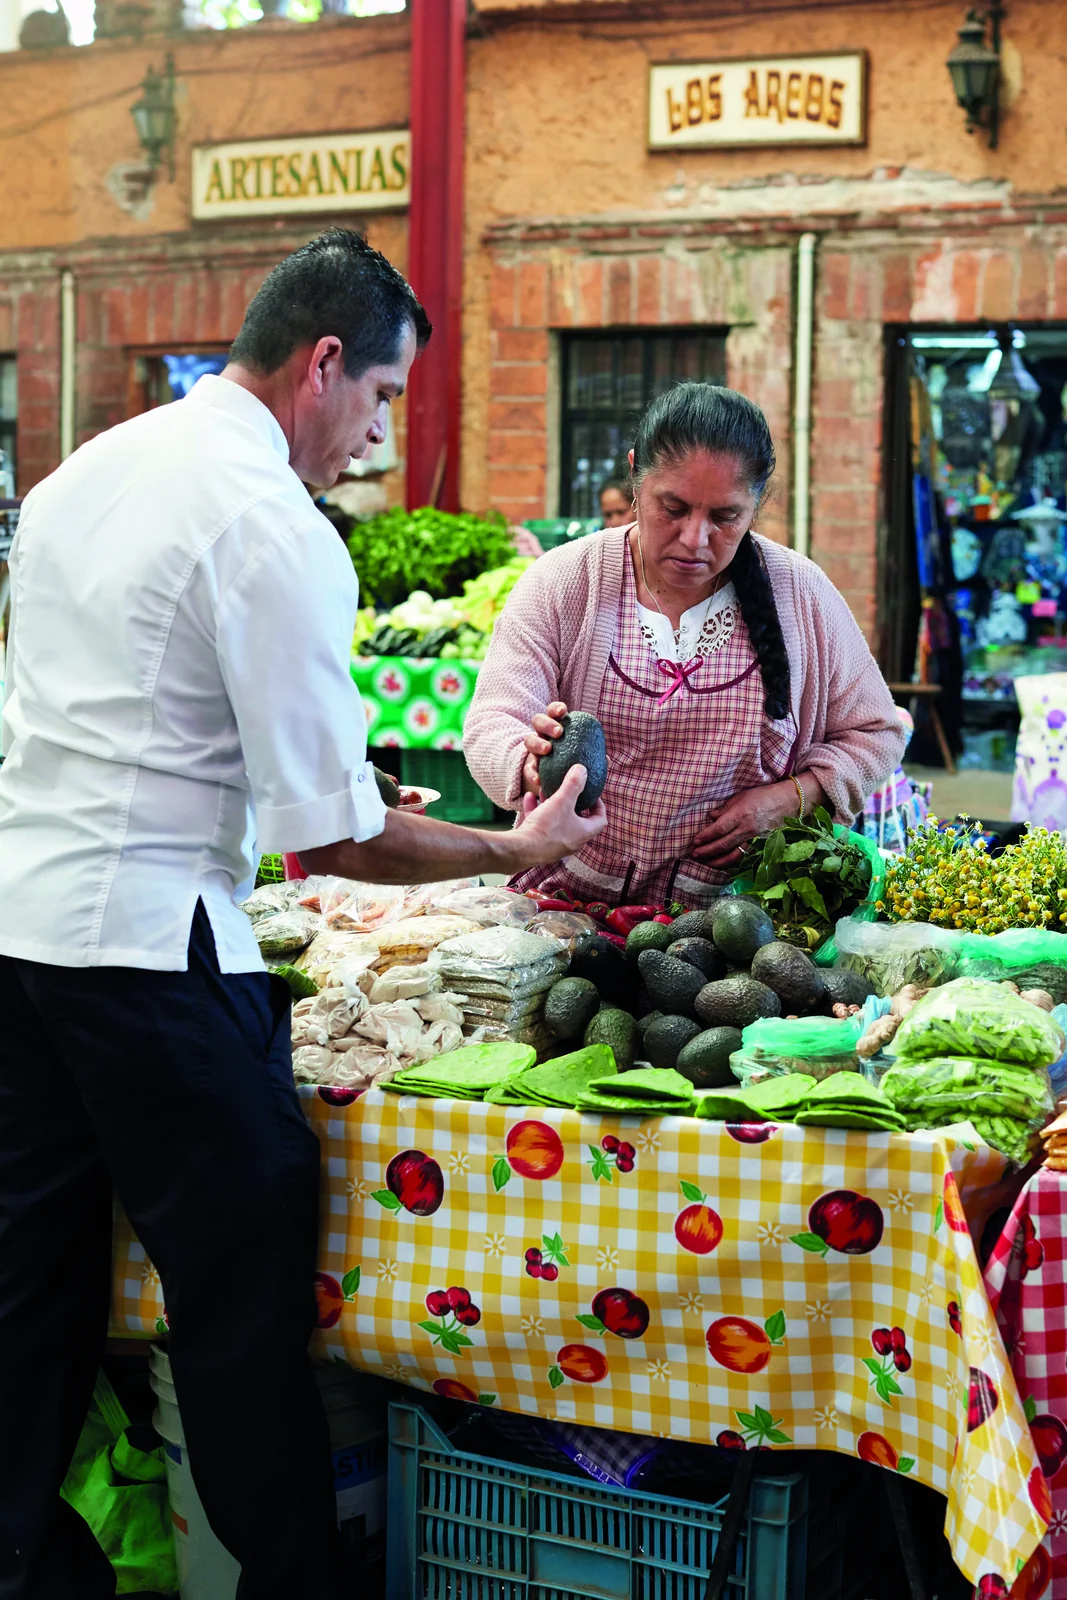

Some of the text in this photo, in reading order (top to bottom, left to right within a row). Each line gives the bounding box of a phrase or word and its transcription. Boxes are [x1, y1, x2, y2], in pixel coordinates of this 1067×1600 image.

[666, 70, 844, 133] LOS ARCOS
[204, 143, 411, 204] ARTESANIAS
